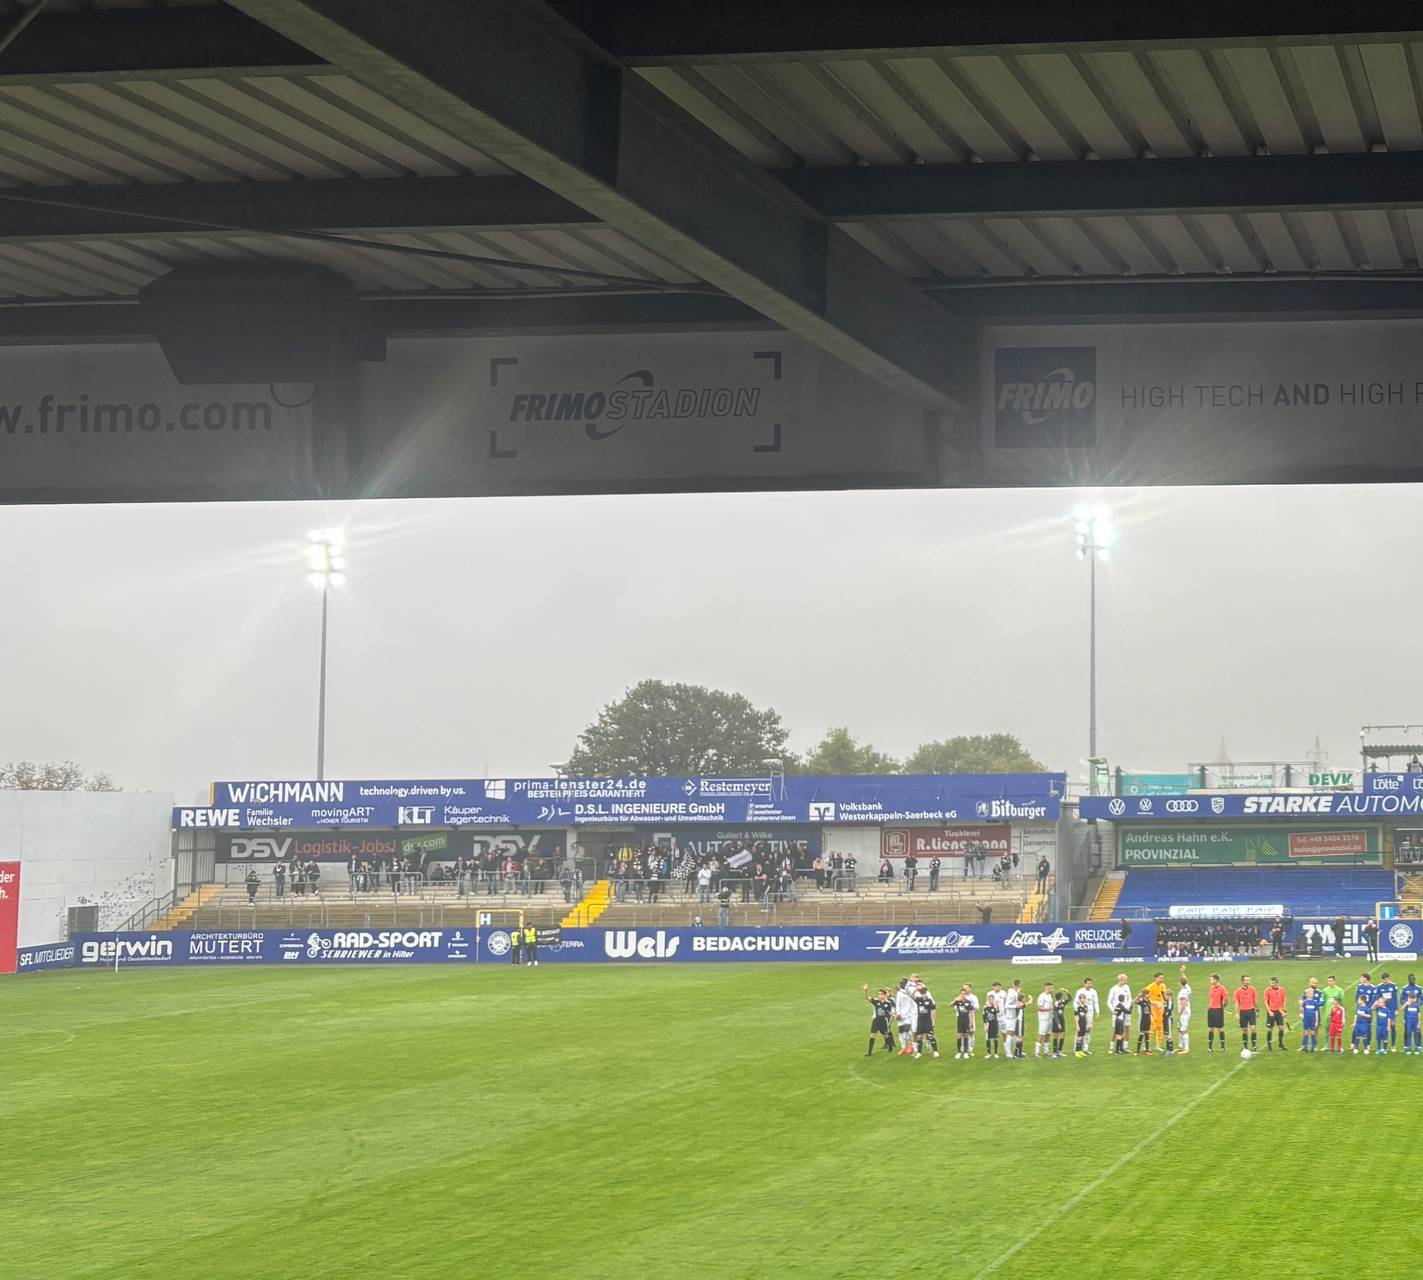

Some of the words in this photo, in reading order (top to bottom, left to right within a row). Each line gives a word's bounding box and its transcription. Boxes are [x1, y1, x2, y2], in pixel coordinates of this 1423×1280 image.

[997, 381, 1096, 411] FRIMO
[1120, 386, 1184, 409] HIGH
[1195, 385, 1263, 408] TECH
[1273, 383, 1331, 406] AND
[1340, 382, 1404, 405] HIGH
[514, 779, 647, 792] prima-fenster24.de
[1308, 773, 1353, 786] DEVK
[1373, 778, 1399, 790] Lotte
[360, 785, 438, 800] technology.driven
[440, 787, 452, 800] by
[453, 789, 466, 798] us.
[700, 780, 771, 795] Restemeyer
[589, 790, 646, 799] GARANTIERT
[444, 805, 483, 817] Käuper
[575, 804, 609, 814] D.S.L.
[611, 804, 685, 814] INGENIEURE
[688, 803, 725, 813] GmbH
[840, 802, 883, 812] Volksbank
[991, 800, 1046, 819] Bitburger
[1243, 796, 1334, 813] STARKE
[181, 809, 240, 827] REWE
[247, 808, 274, 816] Familie
[311, 807, 371, 819] movingART
[398, 806, 436, 824] KLT
[840, 811, 943, 823] Westerkappeln-Saerbeck
[945, 811, 957, 819] eG
[247, 816, 293, 827] Wechsler
[444, 815, 510, 826] Lagertechnik
[1125, 832, 1174, 843] Andreas
[1178, 832, 1207, 842] Hahn
[231, 838, 293, 858] DSV
[294, 841, 396, 858] Logistik-Jobs!
[473, 835, 542, 858] DSV
[1125, 848, 1200, 860] PROVINZIAL
[480, 913, 492, 926] H
[190, 932, 264, 940] ARCHITEKTURBÜRO
[334, 931, 444, 948] RAD-SPORT
[82, 935, 173, 963] gerwin
[190, 939, 264, 954] MUTERT
[605, 931, 680, 958] Wels
[693, 936, 839, 951] BEDACHUNGEN
[20, 952, 34, 967] SFL
[34, 946, 75, 964] MITGLIEDER
[320, 949, 383, 958] SCHRIEWER
